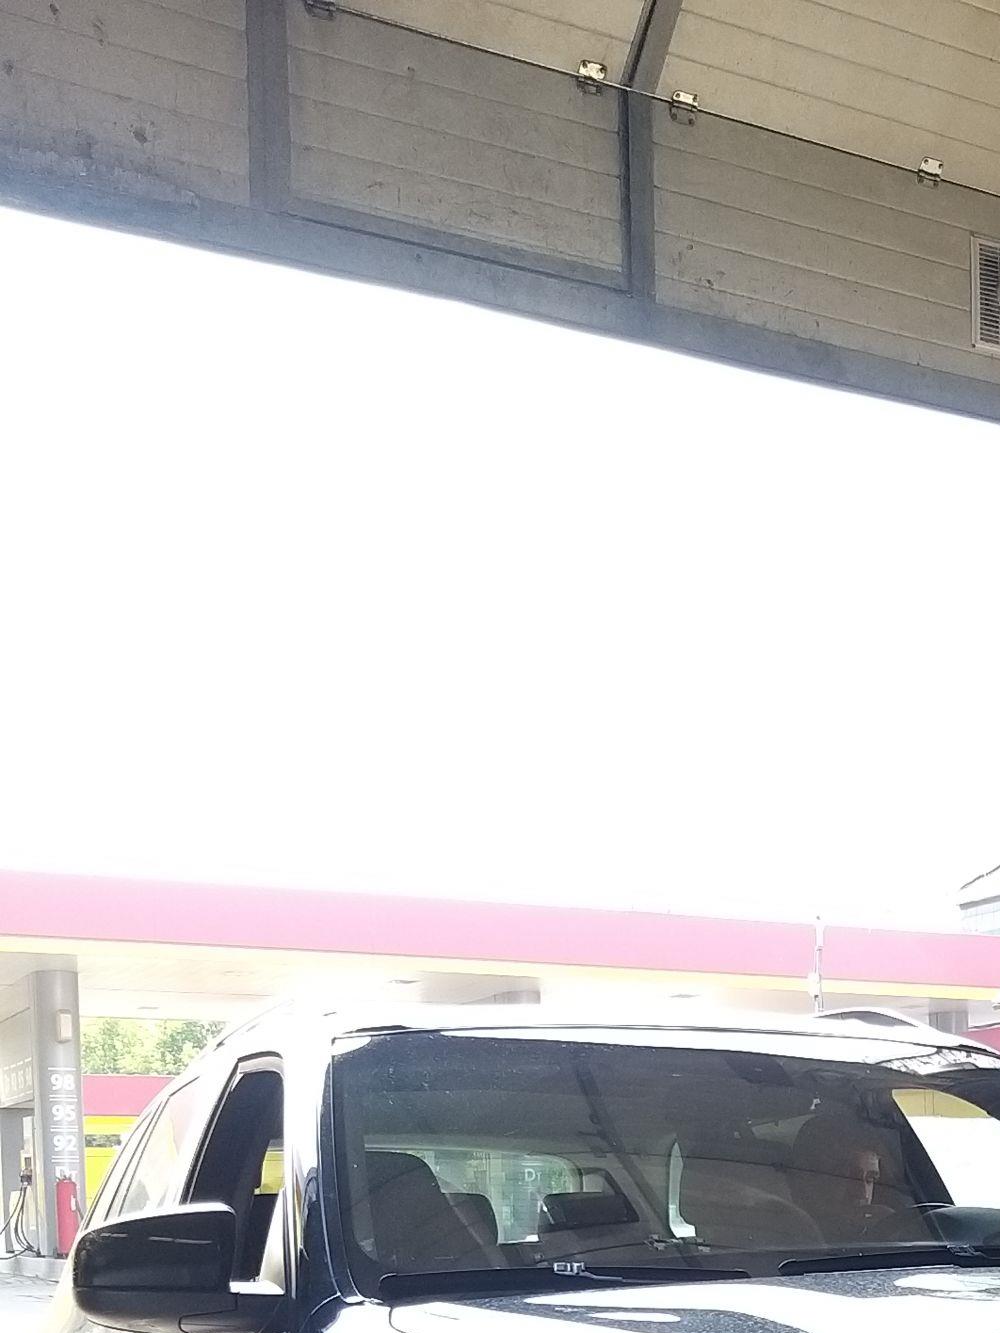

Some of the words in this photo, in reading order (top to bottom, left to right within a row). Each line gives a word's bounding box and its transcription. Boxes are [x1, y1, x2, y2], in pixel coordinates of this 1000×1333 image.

[50, 1073, 76, 1091] 98
[51, 1104, 77, 1122] 95
[53, 1135, 78, 1152] 92
